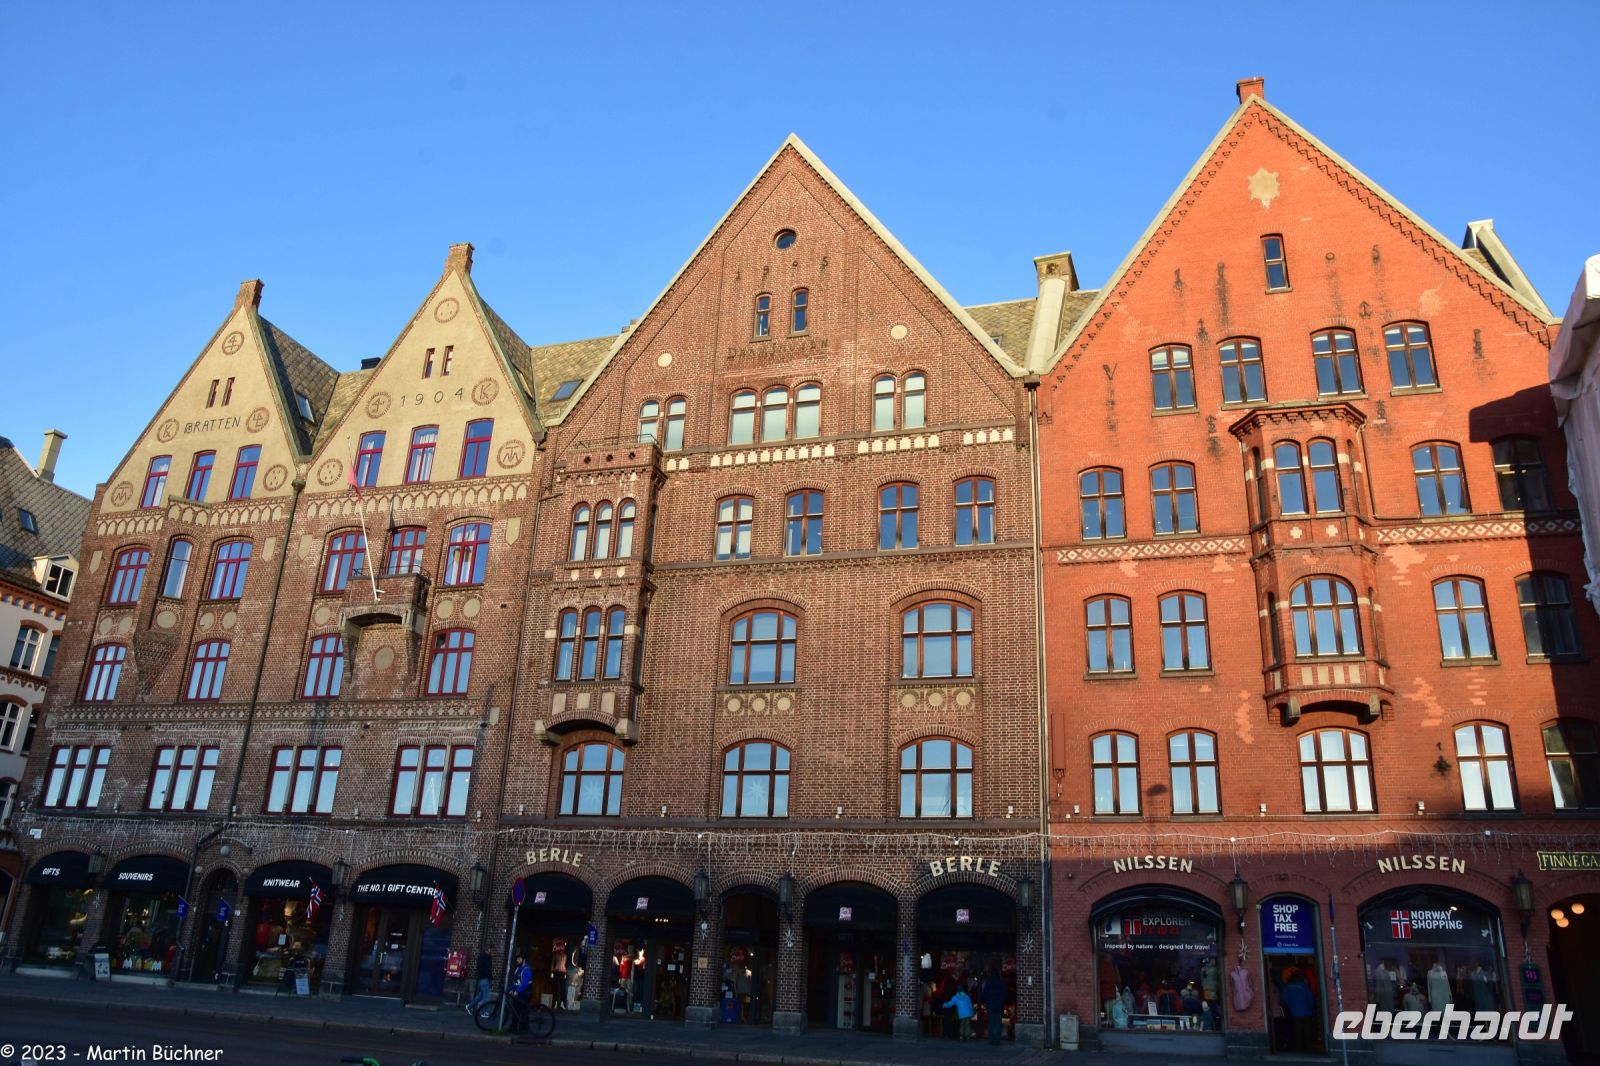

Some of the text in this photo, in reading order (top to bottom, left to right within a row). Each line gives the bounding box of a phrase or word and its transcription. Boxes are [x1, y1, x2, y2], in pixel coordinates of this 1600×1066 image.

[400, 387, 464, 408] 1904
[183, 416, 241, 434] BRATTEN
[525, 847, 584, 868] BERLE
[1541, 854, 1600, 868] FINNEGA
[929, 855, 1002, 878] BERLE
[1112, 855, 1193, 874] NILSSEN
[1377, 854, 1466, 875] NILSSEN
[42, 867, 61, 877] GIFTS
[117, 871, 154, 882] SOUVENIRS
[262, 878, 301, 888] KNITWEAR
[357, 884, 370, 893] THE
[387, 884, 406, 893] GIFT
[1272, 904, 1299, 914] SHOP
[1273, 914, 1293, 923] TAX
[1410, 910, 1452, 920] NORWAY
[1142, 917, 1191, 926] EXPLORER
[1411, 920, 1463, 930] SHOPPING
[1274, 923, 1299, 932] FREE
[1158, 943, 1184, 951] designed
